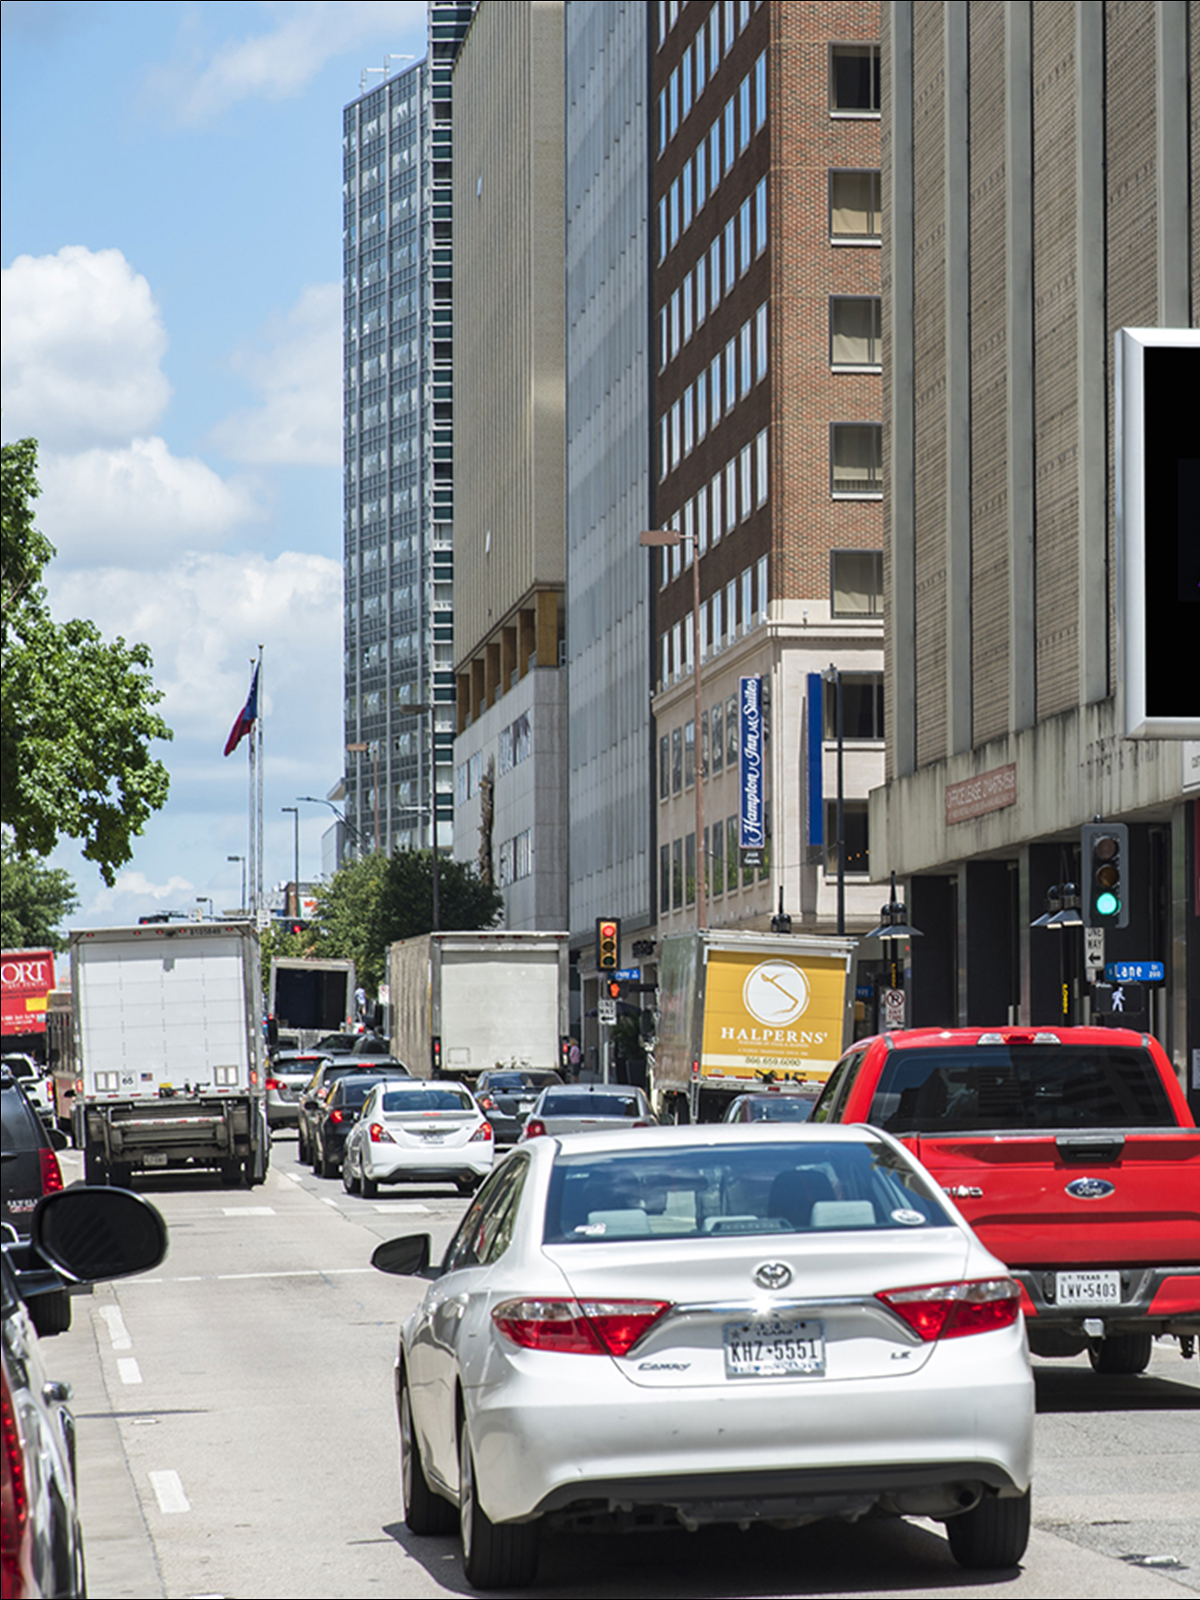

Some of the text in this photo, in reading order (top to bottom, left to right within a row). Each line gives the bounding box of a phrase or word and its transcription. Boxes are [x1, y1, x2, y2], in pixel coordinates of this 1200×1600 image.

[743, 679, 759, 720] Suites
[744, 731, 760, 767] Inn
[743, 768, 761, 843] Hampton
[1, 961, 48, 984] ORT
[1114, 964, 1142, 977] Lane
[721, 1027, 828, 1045] HALPERNS'
[1077, 1182, 1104, 1195] Ford
[891, 1351, 911, 1360] LE
[638, 1362, 691, 1371] CAMRY
